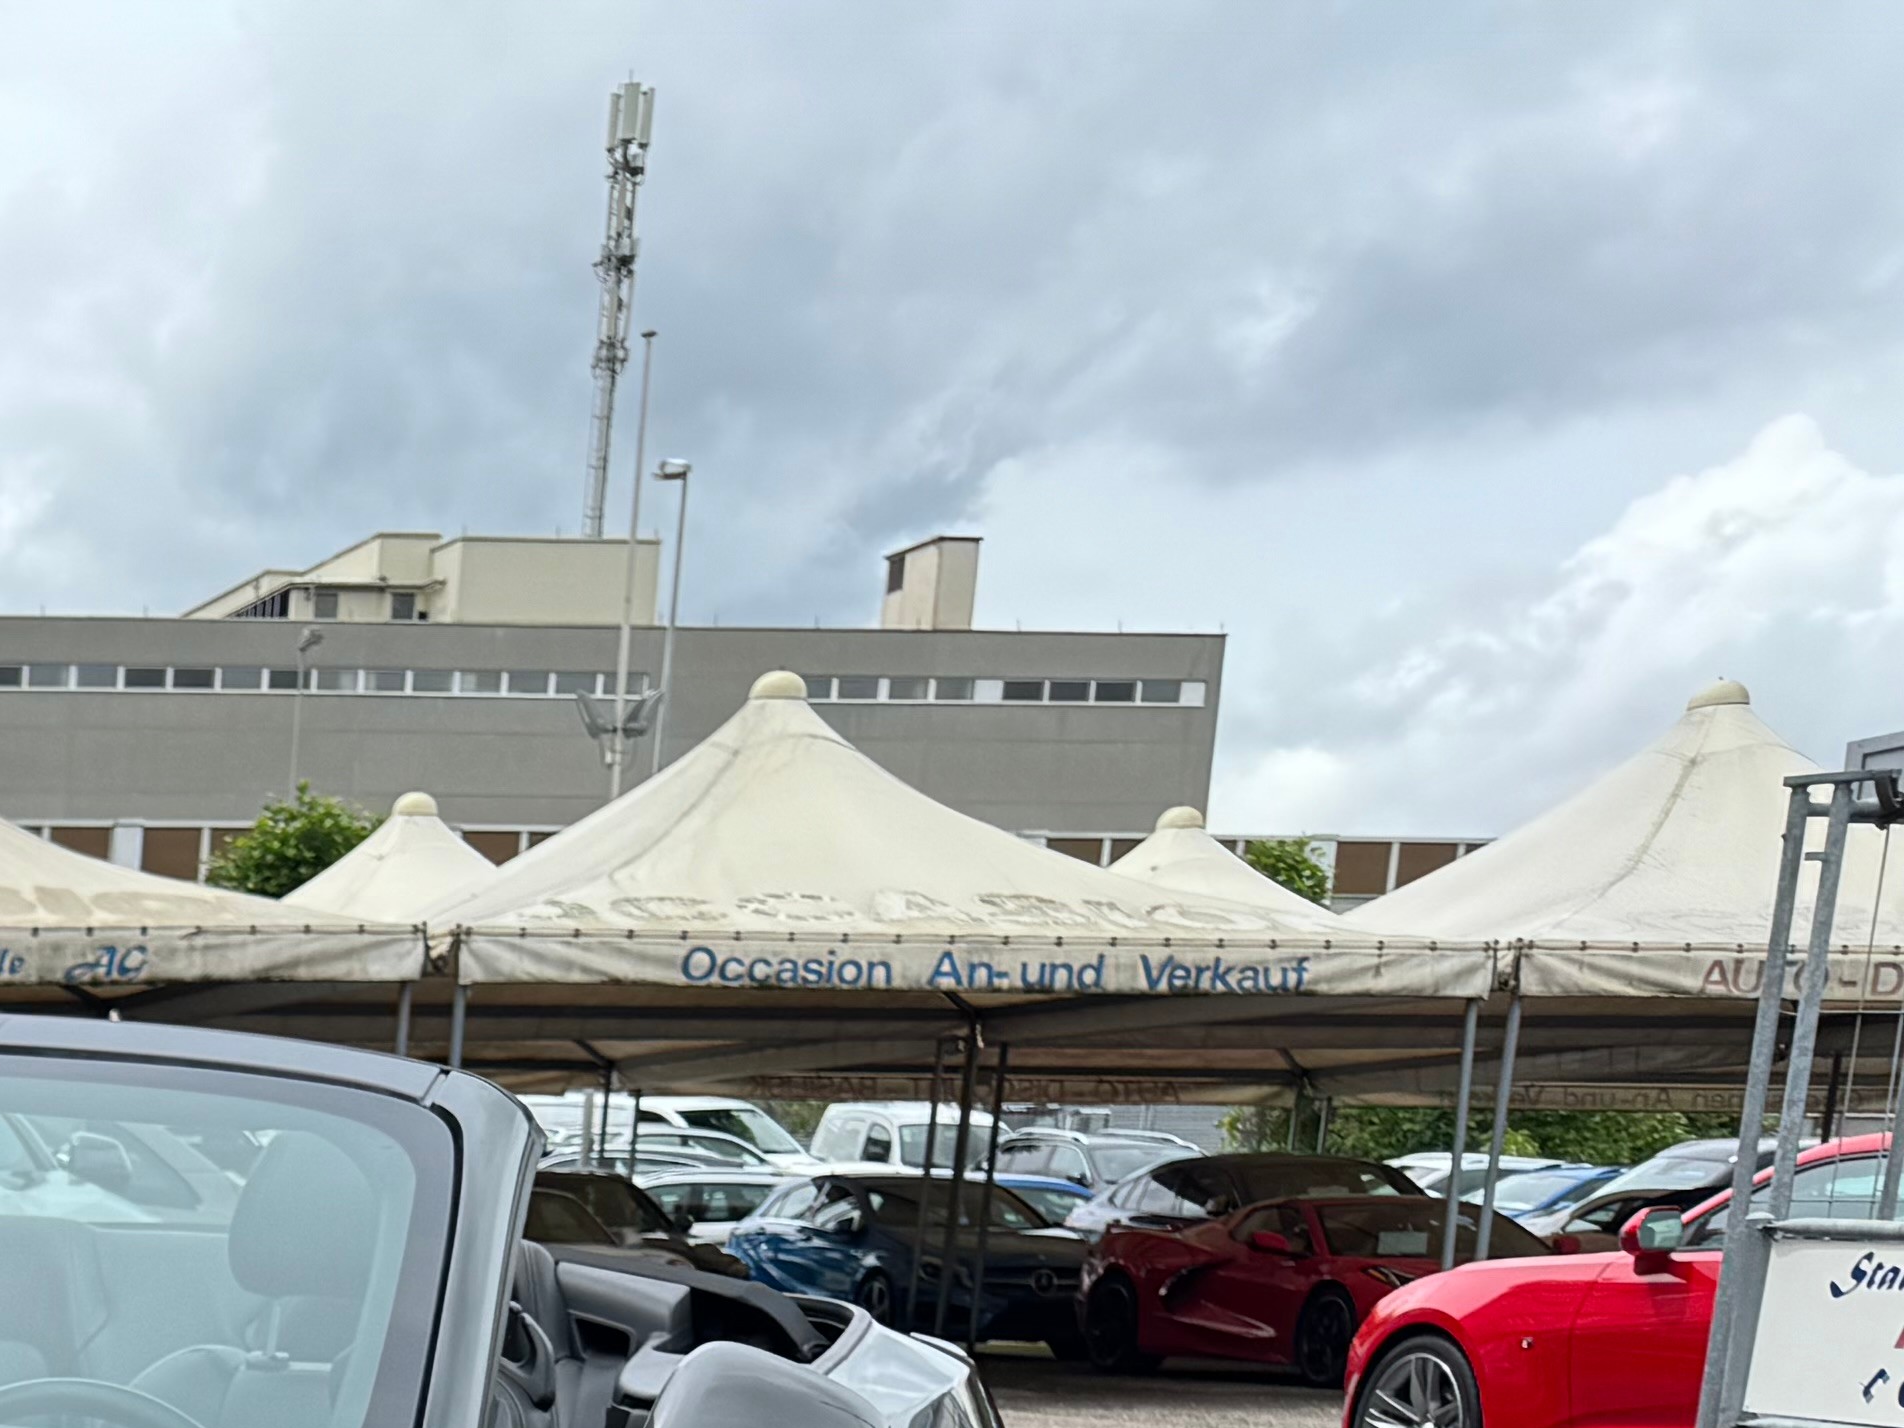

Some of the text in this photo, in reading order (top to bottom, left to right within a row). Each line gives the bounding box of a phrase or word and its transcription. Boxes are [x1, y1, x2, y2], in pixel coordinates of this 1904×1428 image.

[64, 945, 148, 984] AG
[681, 946, 893, 987] Occasion
[1020, 953, 1105, 991] und
[1140, 953, 1310, 994] Verkauf
[1830, 1251, 1904, 1299] Sta
